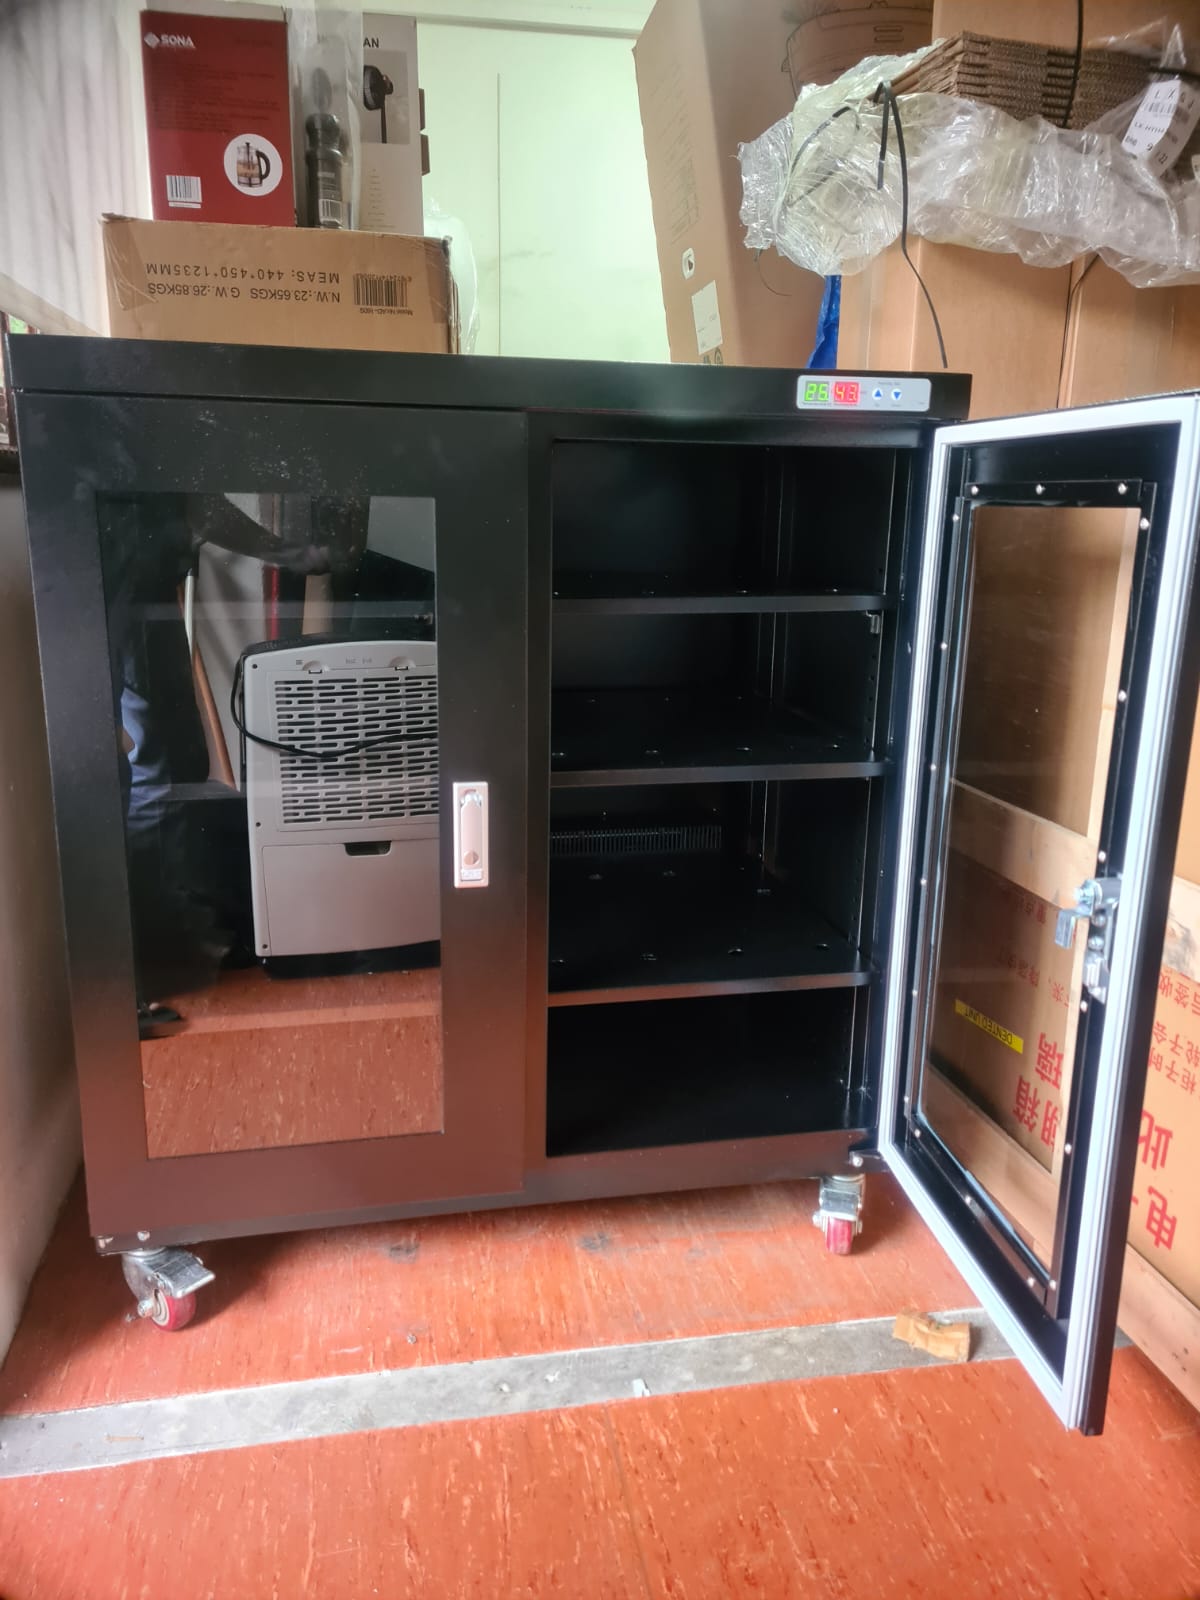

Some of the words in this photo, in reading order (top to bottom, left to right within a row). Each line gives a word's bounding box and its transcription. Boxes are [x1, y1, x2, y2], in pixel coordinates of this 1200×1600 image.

[160, 34, 196, 49] SONA
[980, 1013, 1013, 1046] DENTED
[1131, 1185, 1178, 1252] 电
